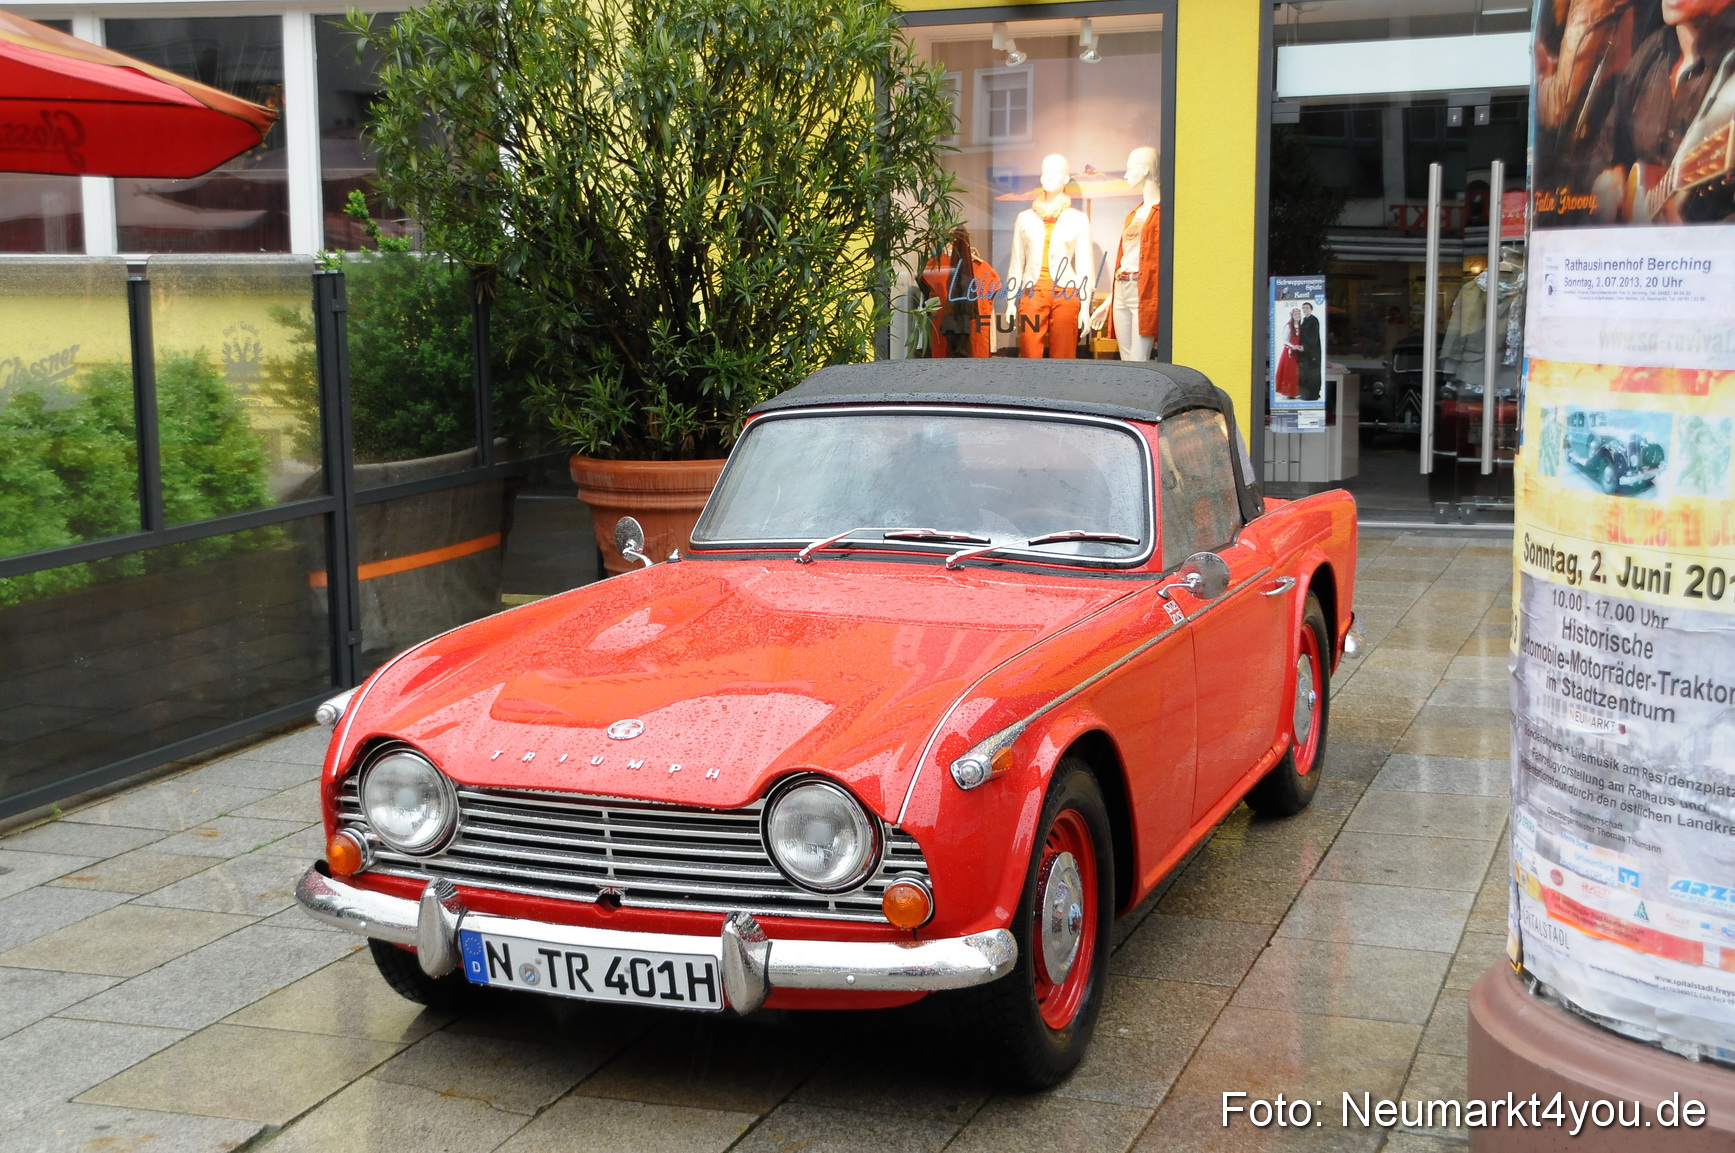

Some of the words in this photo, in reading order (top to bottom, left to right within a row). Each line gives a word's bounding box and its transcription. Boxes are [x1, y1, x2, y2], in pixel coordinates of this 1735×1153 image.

[1558, 186, 1598, 216] Groovy
[948, 258, 1037, 302] Leinen
[1563, 277, 1594, 290] Sonntag,
[1645, 276, 1658, 288] 20
[1662, 276, 1684, 288] Uhr
[1647, 257, 1712, 274] Berching
[1523, 531, 1583, 585] Sonntag,
[1589, 549, 1607, 584] 2.
[1616, 556, 1673, 596] Juni
[1552, 588, 1583, 612] 10.00
[1594, 600, 1635, 623] 17.00
[1639, 607, 1669, 630] Uhr
[1561, 615, 1654, 660] Historische
[1545, 670, 1557, 693] im
[1561, 676, 1675, 724] Stadtzentrum
[1568, 708, 1616, 733] NEUMARKT
[490, 749, 721, 780] TRIUMPH
[1531, 747, 1605, 791] Fahrzeugvorstellung
[1607, 781, 1625, 794] am
[1627, 783, 1676, 807] Rathaus
[1679, 799, 1708, 813] und
[1571, 745, 1619, 771] Livemusik
[1622, 764, 1640, 777] am
[1568, 783, 1594, 802] durch
[1596, 796, 1617, 809] den
[1619, 798, 1672, 824] östlichen
[1569, 805, 1623, 831] Schirmherrschaft
[1546, 806, 1595, 833] Oberbürgermeister
[1596, 827, 1626, 843] Thomas
[1627, 835, 1662, 854] Thumann
[1521, 906, 1570, 950] SPITALSTADL
[471, 960, 481, 973] D
[485, 939, 514, 982] N
[537, 947, 595, 993] TR
[604, 955, 717, 1003] 401H
